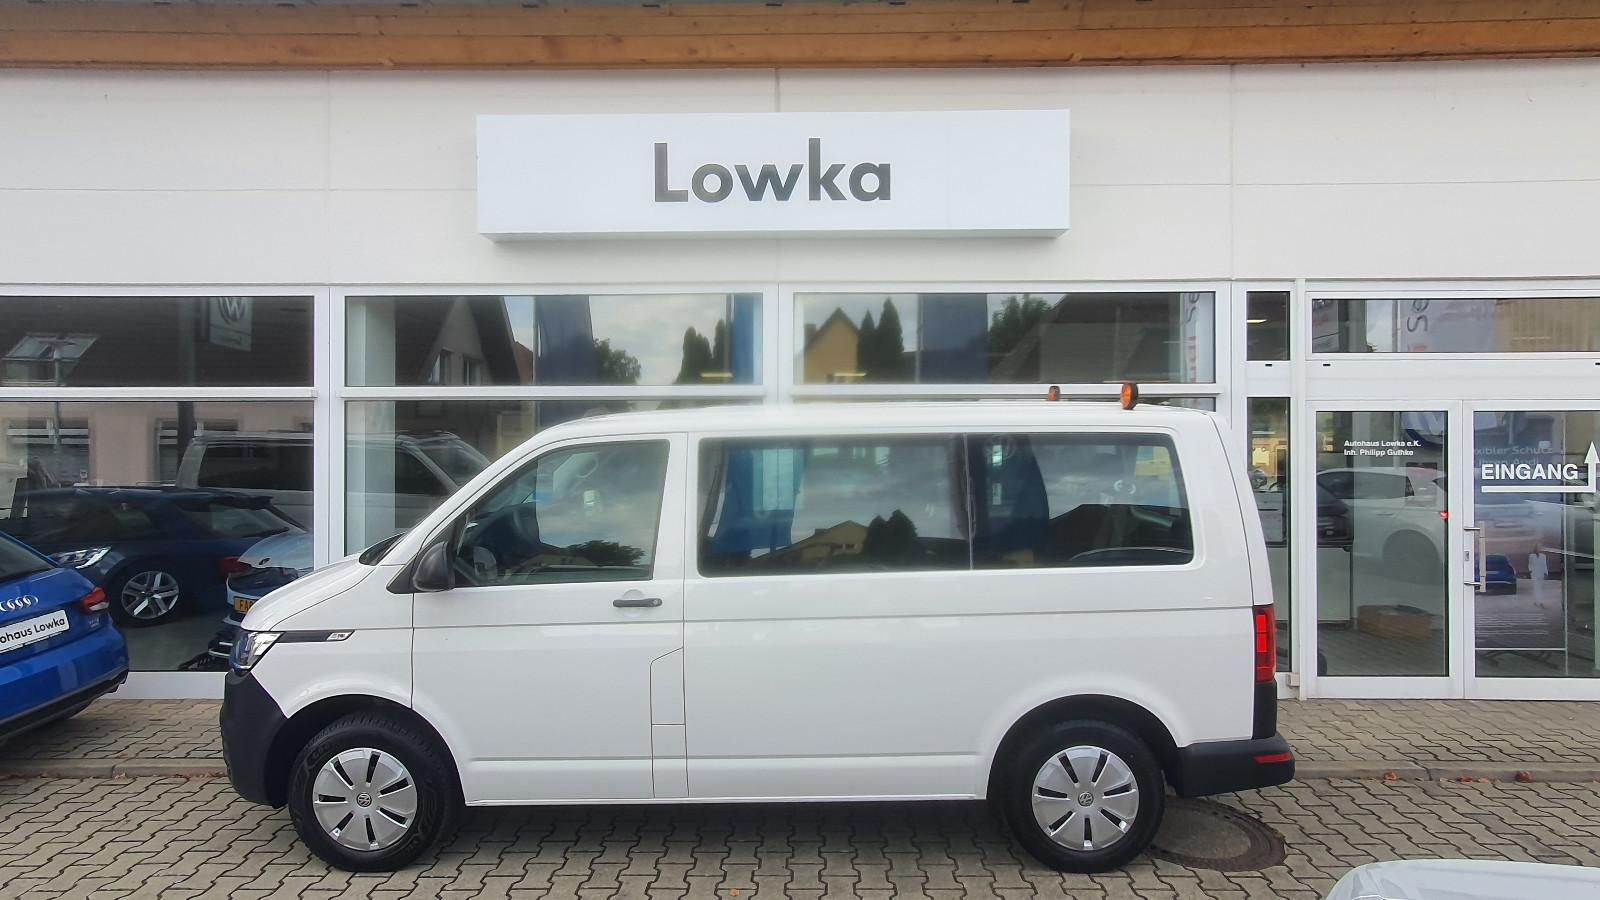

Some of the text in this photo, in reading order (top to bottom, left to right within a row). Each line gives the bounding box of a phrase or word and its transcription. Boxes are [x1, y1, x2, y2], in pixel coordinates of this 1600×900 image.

[654, 137, 892, 203] Lowka
[1360, 449, 1386, 458] Philipp
[1481, 463, 1579, 480] EINGANG
[34, 618, 65, 633] Lowka
